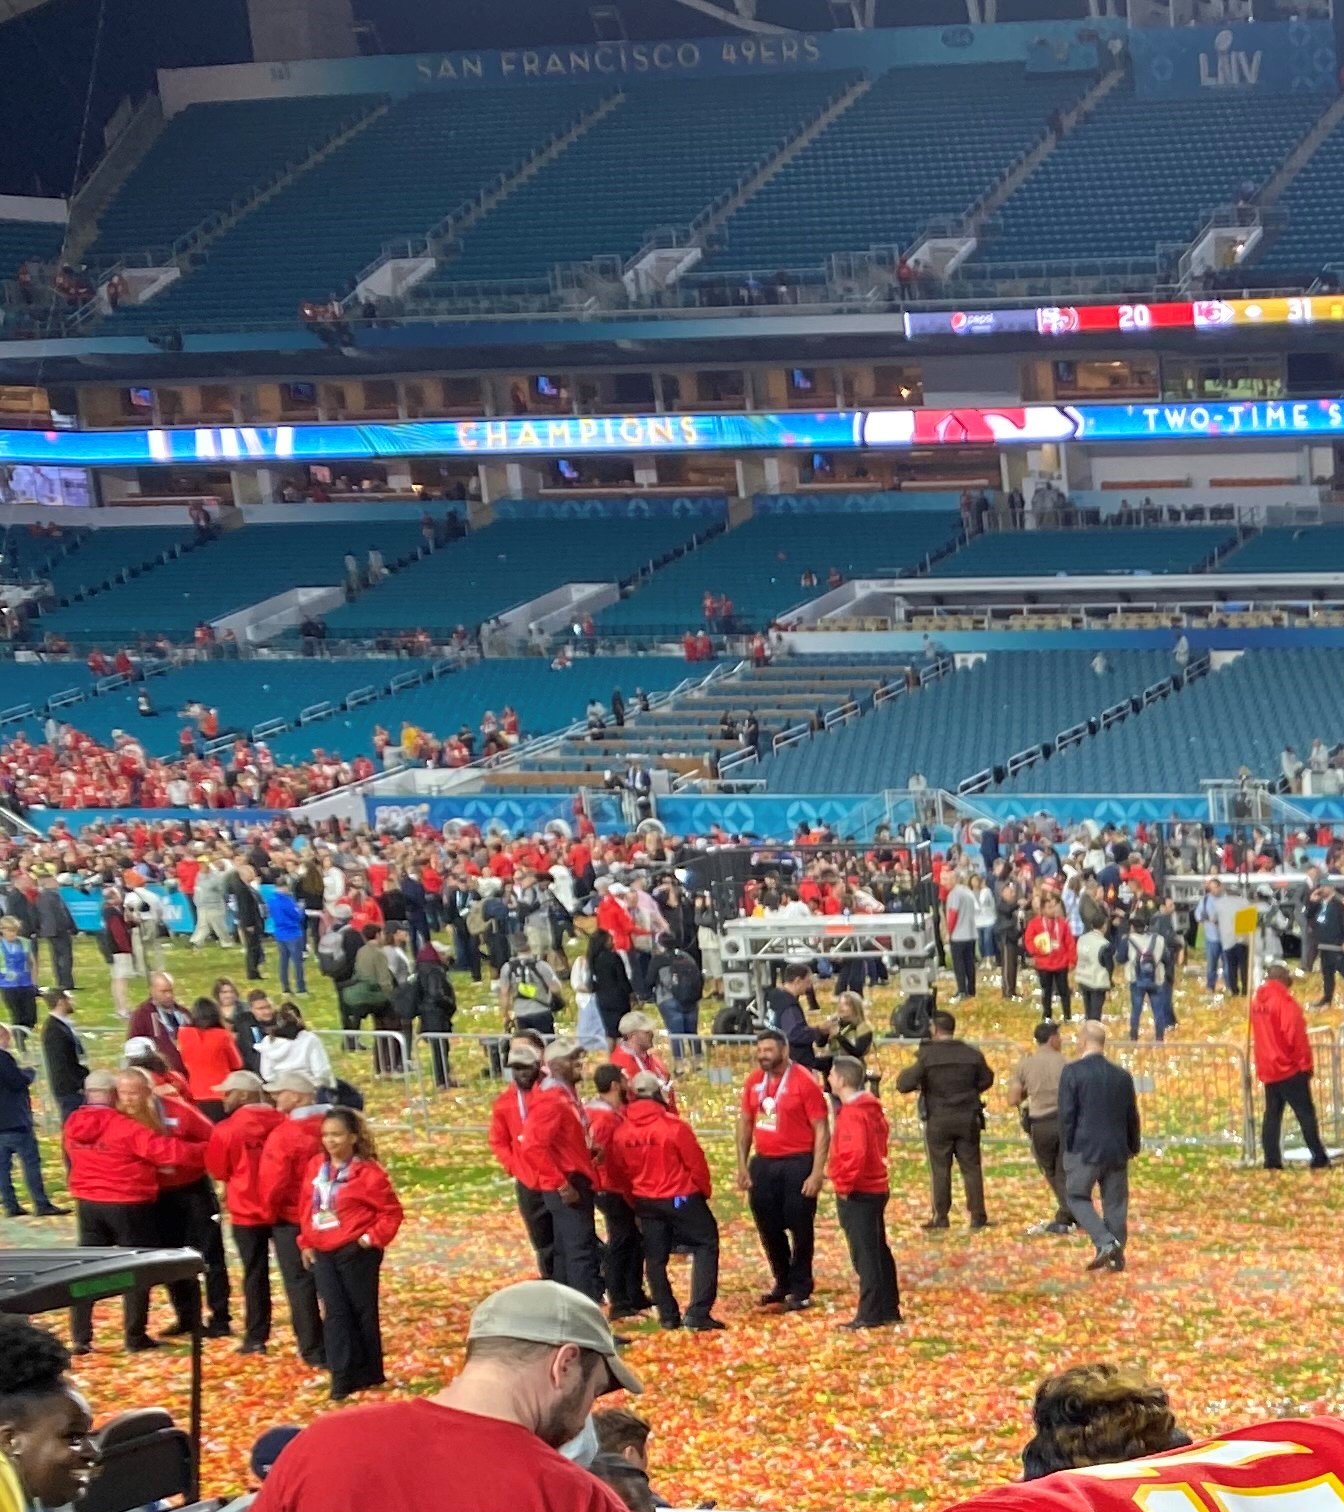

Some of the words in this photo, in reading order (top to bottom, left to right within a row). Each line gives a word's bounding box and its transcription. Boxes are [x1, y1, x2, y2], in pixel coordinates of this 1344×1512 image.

[416, 54, 482, 80] SAN
[502, 43, 699, 76] FRANCISCO
[720, 37, 820, 66] 49ERS
[1199, 50, 1262, 86] LIV
[1118, 305, 1150, 327] 20
[1287, 300, 1312, 320] 31
[457, 415, 699, 449] CHAMPIONS
[1144, 402, 1308, 432] TWO-TIME
